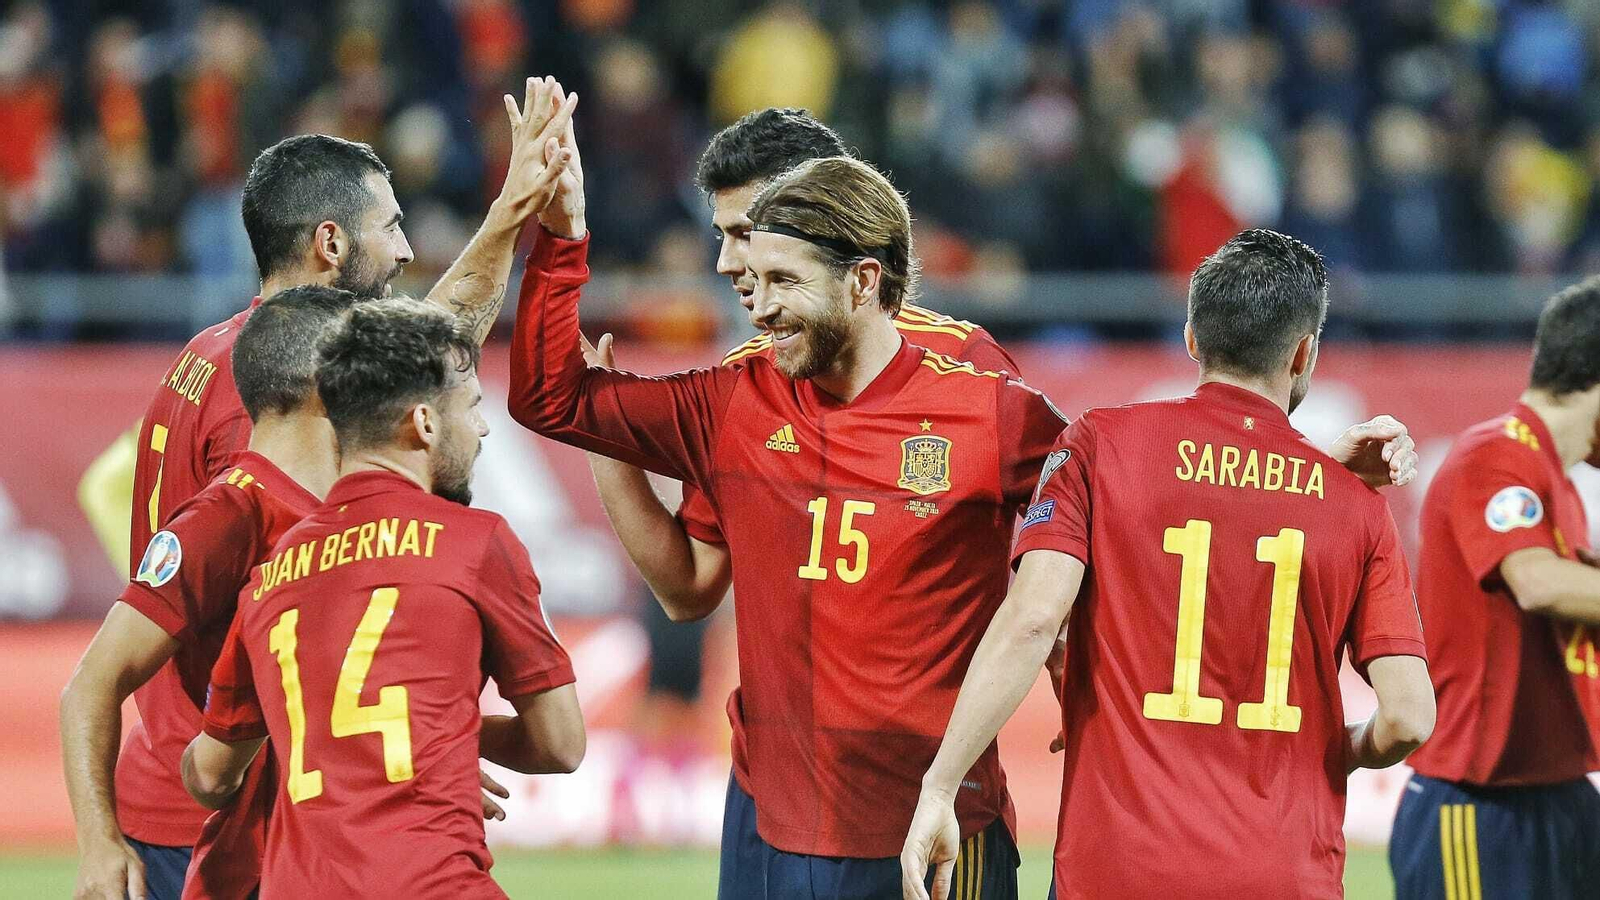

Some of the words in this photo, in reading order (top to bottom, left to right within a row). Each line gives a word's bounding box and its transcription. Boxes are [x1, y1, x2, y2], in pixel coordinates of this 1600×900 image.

[765, 440, 800, 453] adidas
[1175, 439, 1325, 500] SARABIA
[253, 540, 317, 601] JUAN
[319, 518, 444, 572] BERNAT
[798, 496, 876, 584] 15
[1143, 518, 1305, 733] 11
[269, 587, 414, 804] 14
